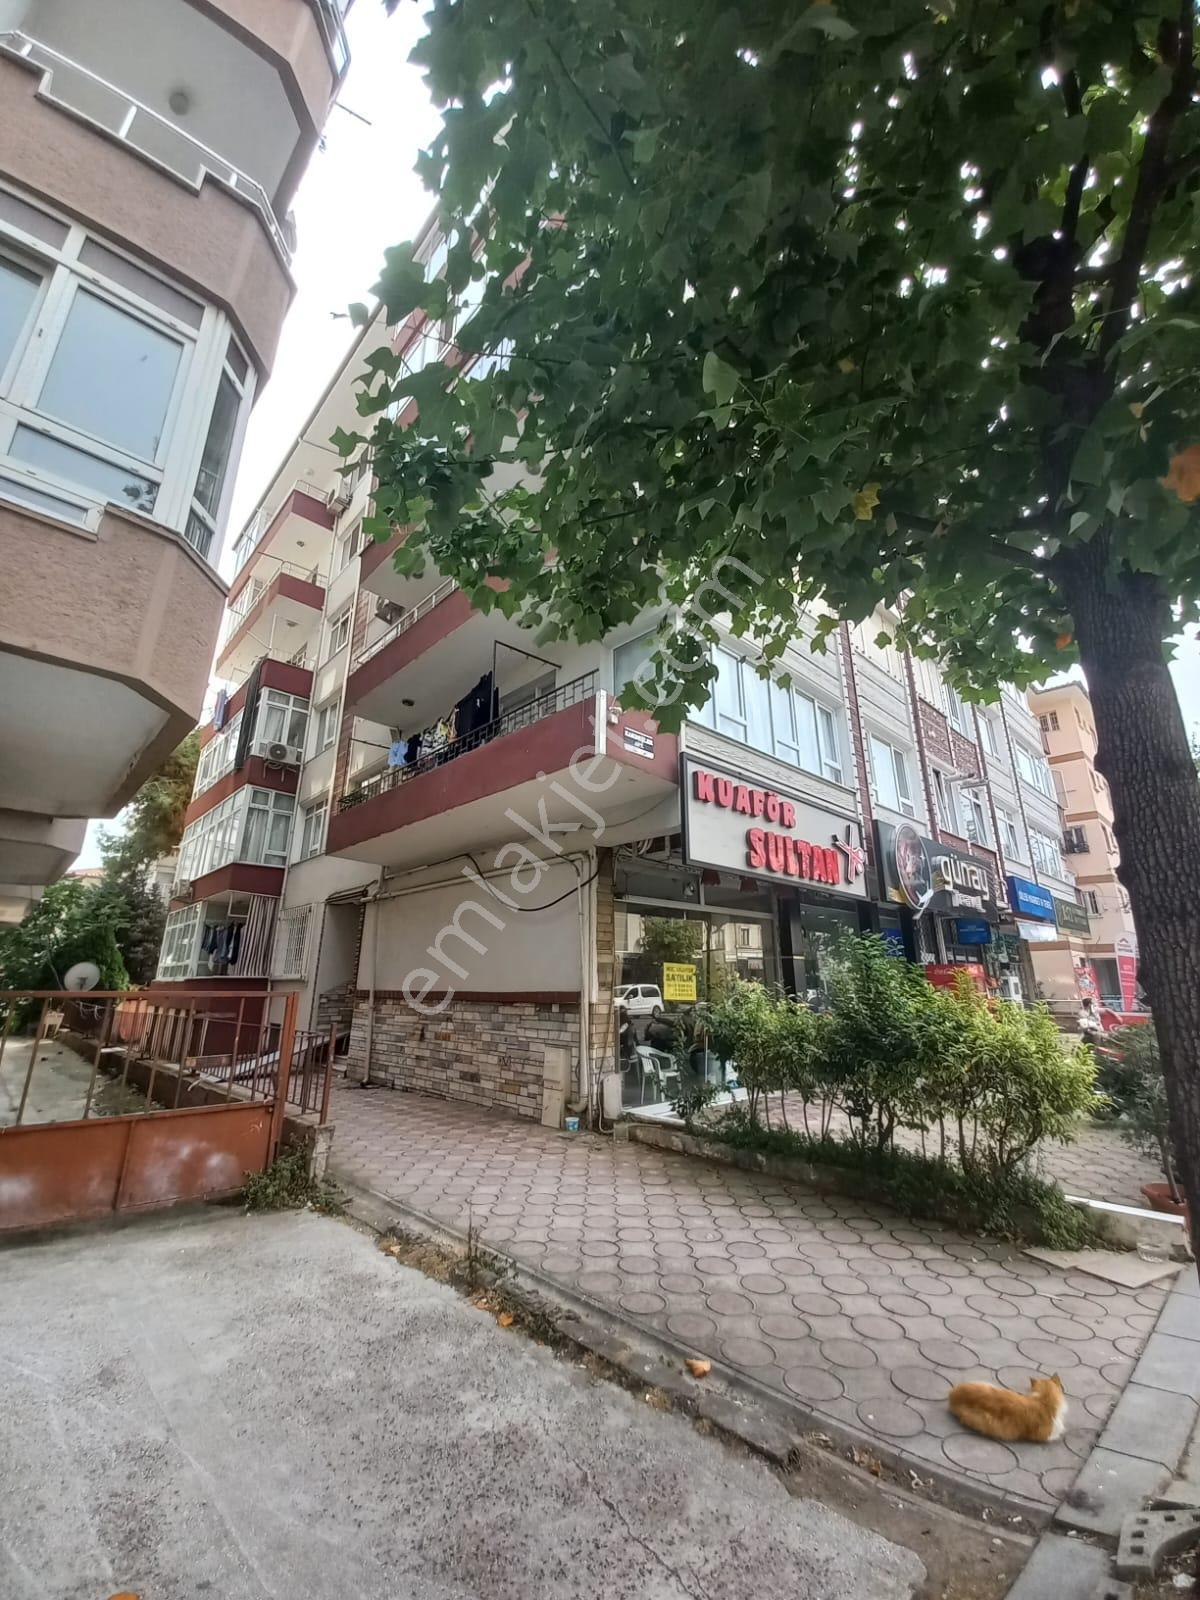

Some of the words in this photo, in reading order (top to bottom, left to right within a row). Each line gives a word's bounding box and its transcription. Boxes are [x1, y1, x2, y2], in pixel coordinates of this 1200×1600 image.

[694, 770, 796, 828] KUAFÖR
[746, 827, 840, 885] SULTAN
[940, 853, 990, 901] günay
